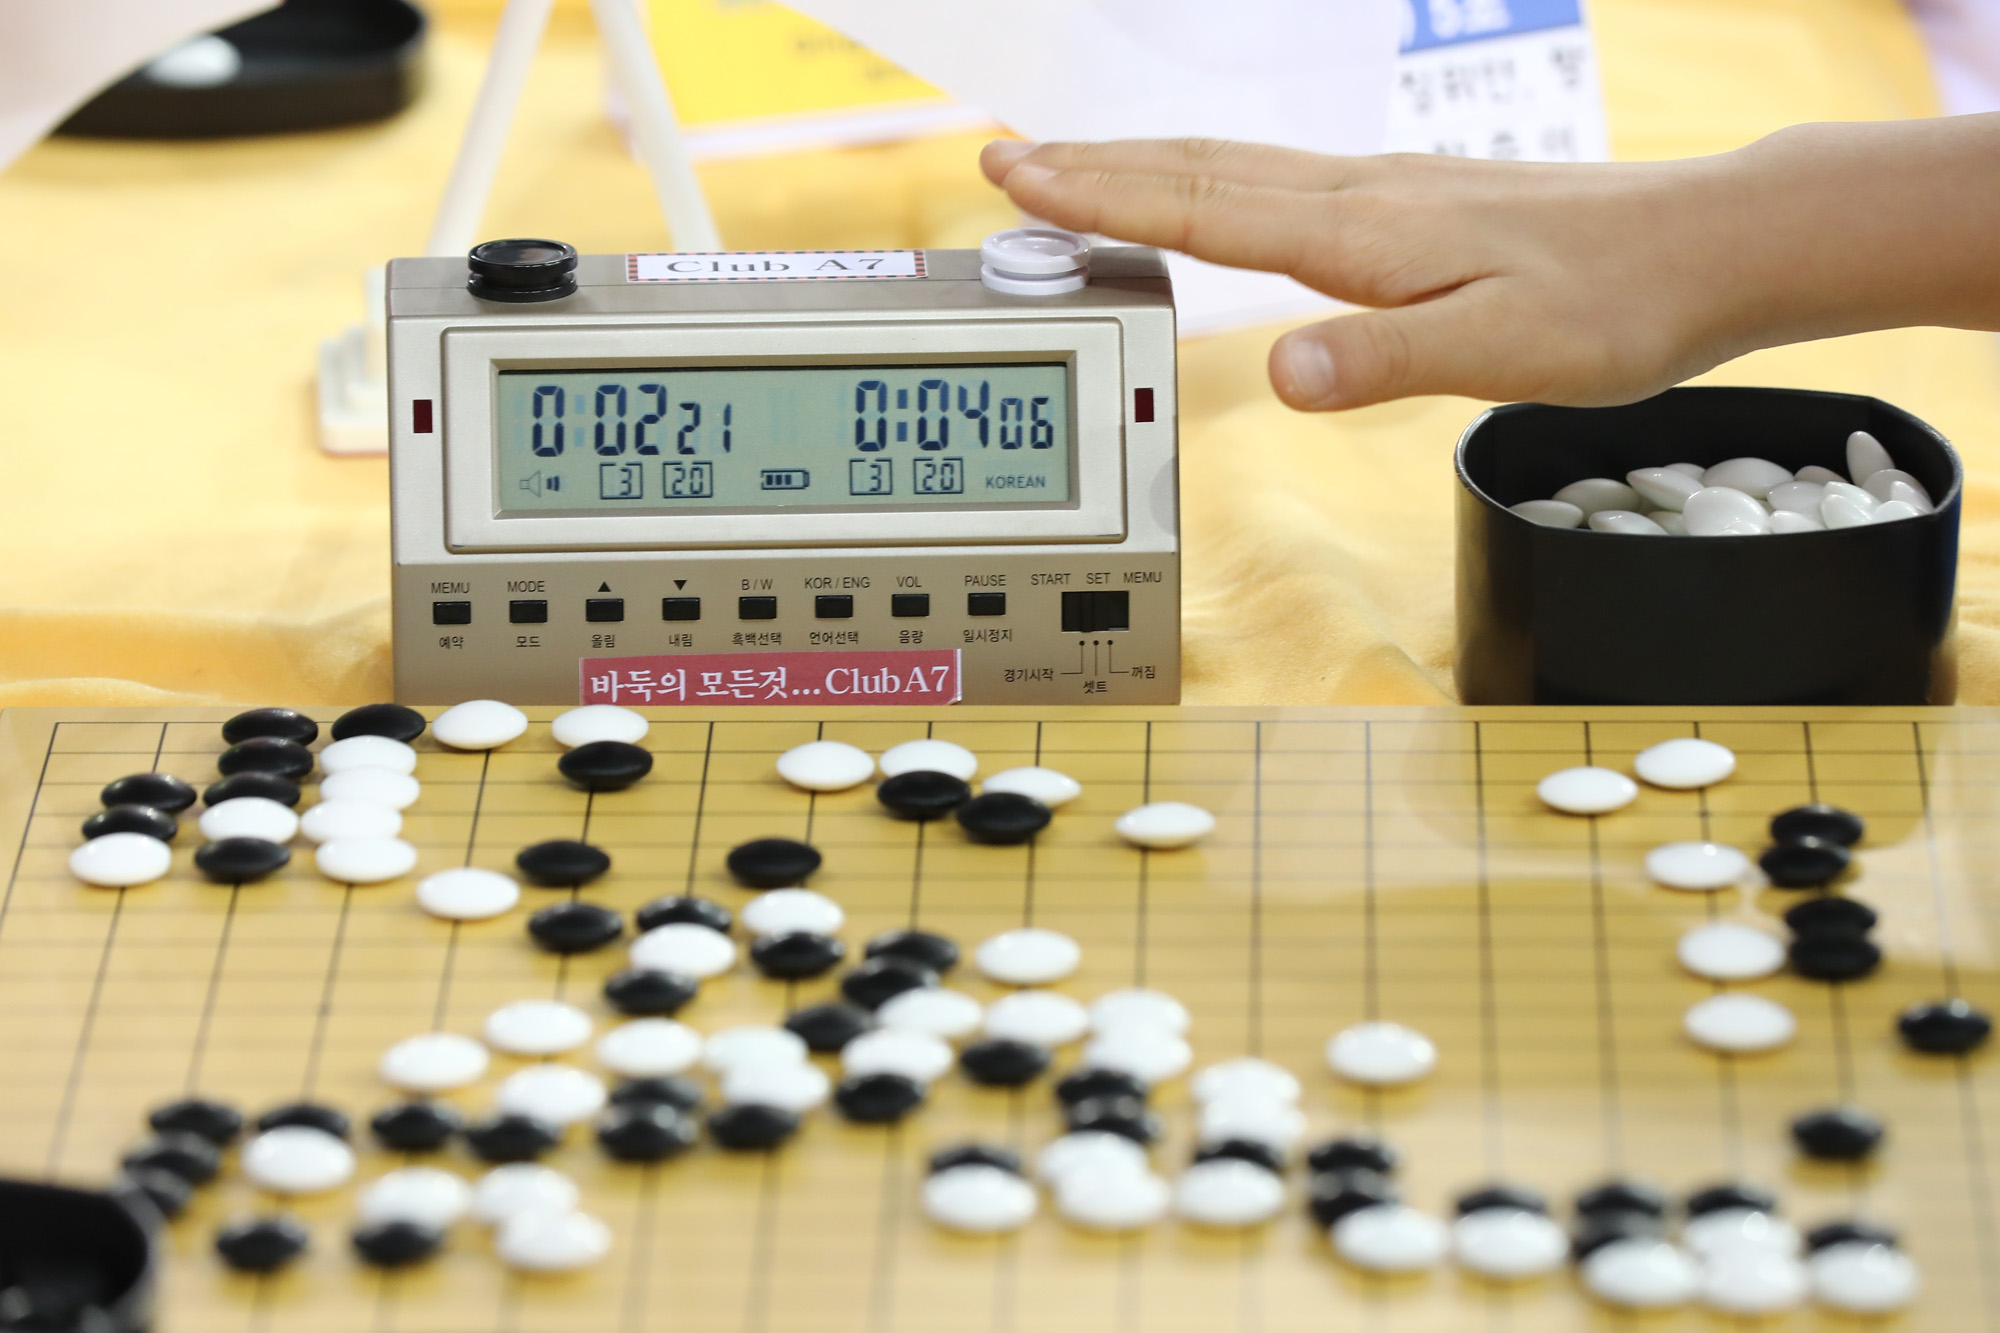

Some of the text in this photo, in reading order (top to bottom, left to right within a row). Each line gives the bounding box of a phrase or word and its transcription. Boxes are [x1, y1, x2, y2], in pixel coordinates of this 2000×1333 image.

[666, 257, 885, 274] Club A7
[619, 467, 632, 496] 3
[672, 467, 703, 494] 20
[869, 464, 882, 492] 3
[922, 463, 954, 491] 20
[985, 475, 1046, 489] KOREAN
[896, 576, 922, 587] VOL
[964, 574, 1007, 587] PAUSE
[1031, 571, 1162, 585] START SET MEMU
[431, 582, 470, 594] MEMU
[507, 580, 545, 592] MODE
[439, 635, 464, 649] 예약
[515, 635, 540, 648] 모드
[591, 634, 615, 649] 올림
[668, 633, 692, 647] 내림
[732, 631, 782, 646] 흑백선택
[809, 630, 859, 645] 언어선택
[898, 629, 923, 644] 음량
[963, 628, 1013, 643] 일시정지
[1003, 667, 1054, 682] 경기시작
[1131, 665, 1156, 680] 꺼짐
[590, 668, 686, 703] 바둑의
